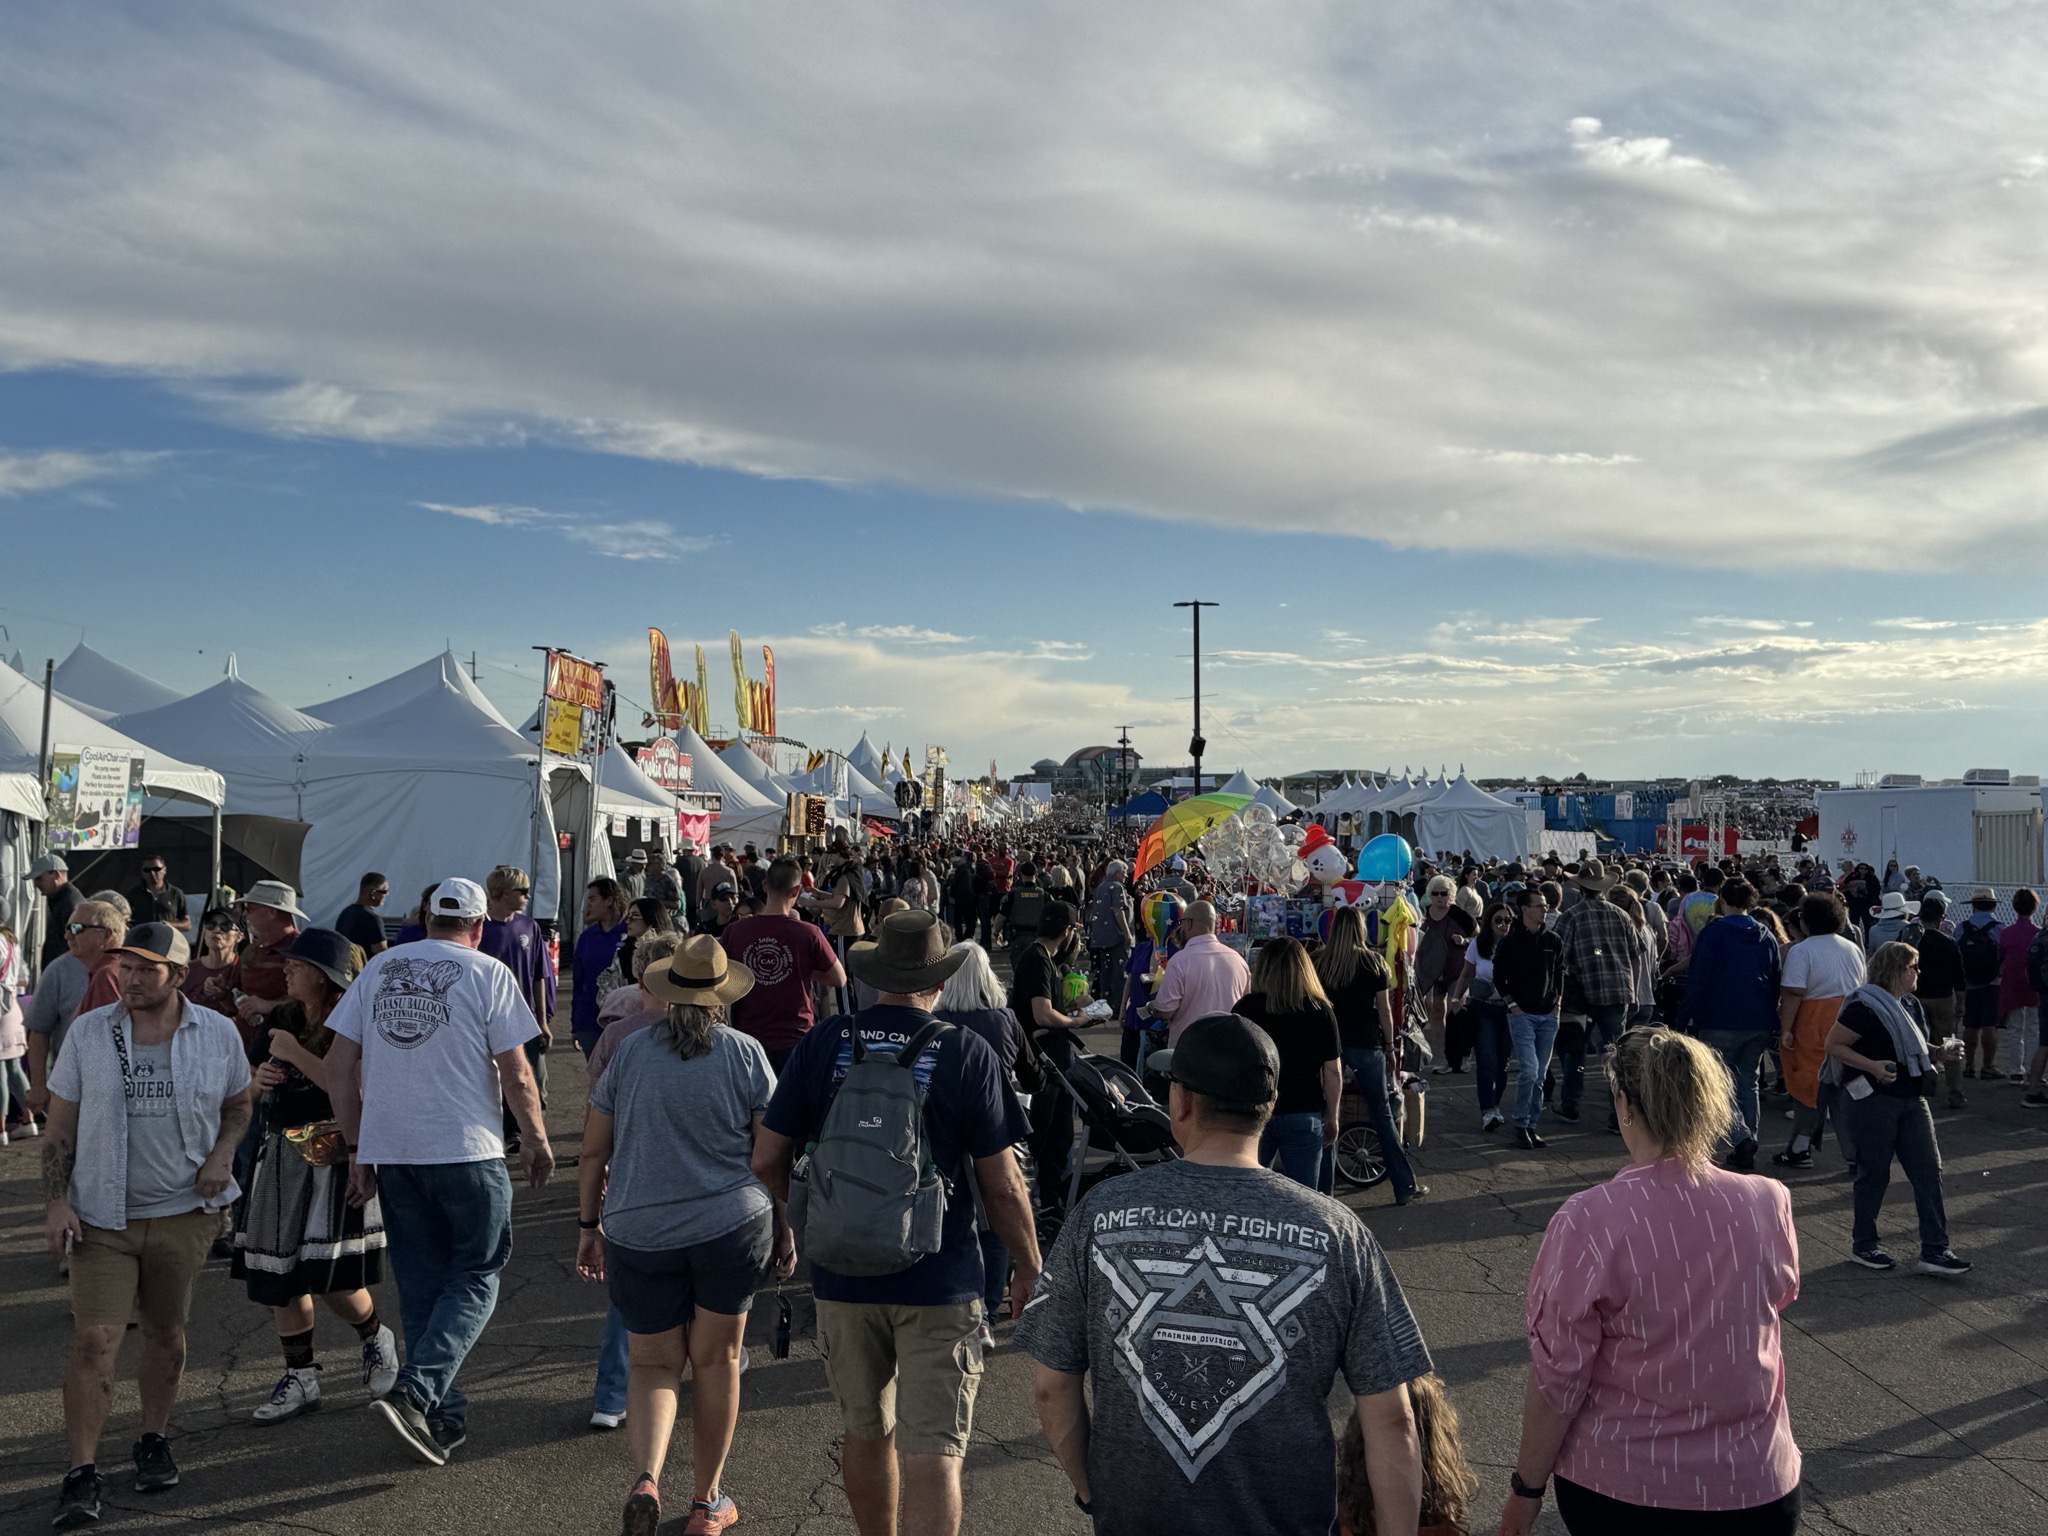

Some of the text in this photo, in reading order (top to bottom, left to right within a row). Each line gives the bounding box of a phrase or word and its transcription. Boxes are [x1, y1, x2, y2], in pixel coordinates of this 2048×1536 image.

[418, 1012, 436, 1024] FAIR
[841, 1029, 885, 1040] GAND
[1094, 1208, 1330, 1252] AMERICAN FIGHTER
[1156, 1331, 1238, 1347] TRAINING DIVISION
[1284, 1326, 1298, 1338] 19
[1154, 1372, 1236, 1410] ATHLETICS
